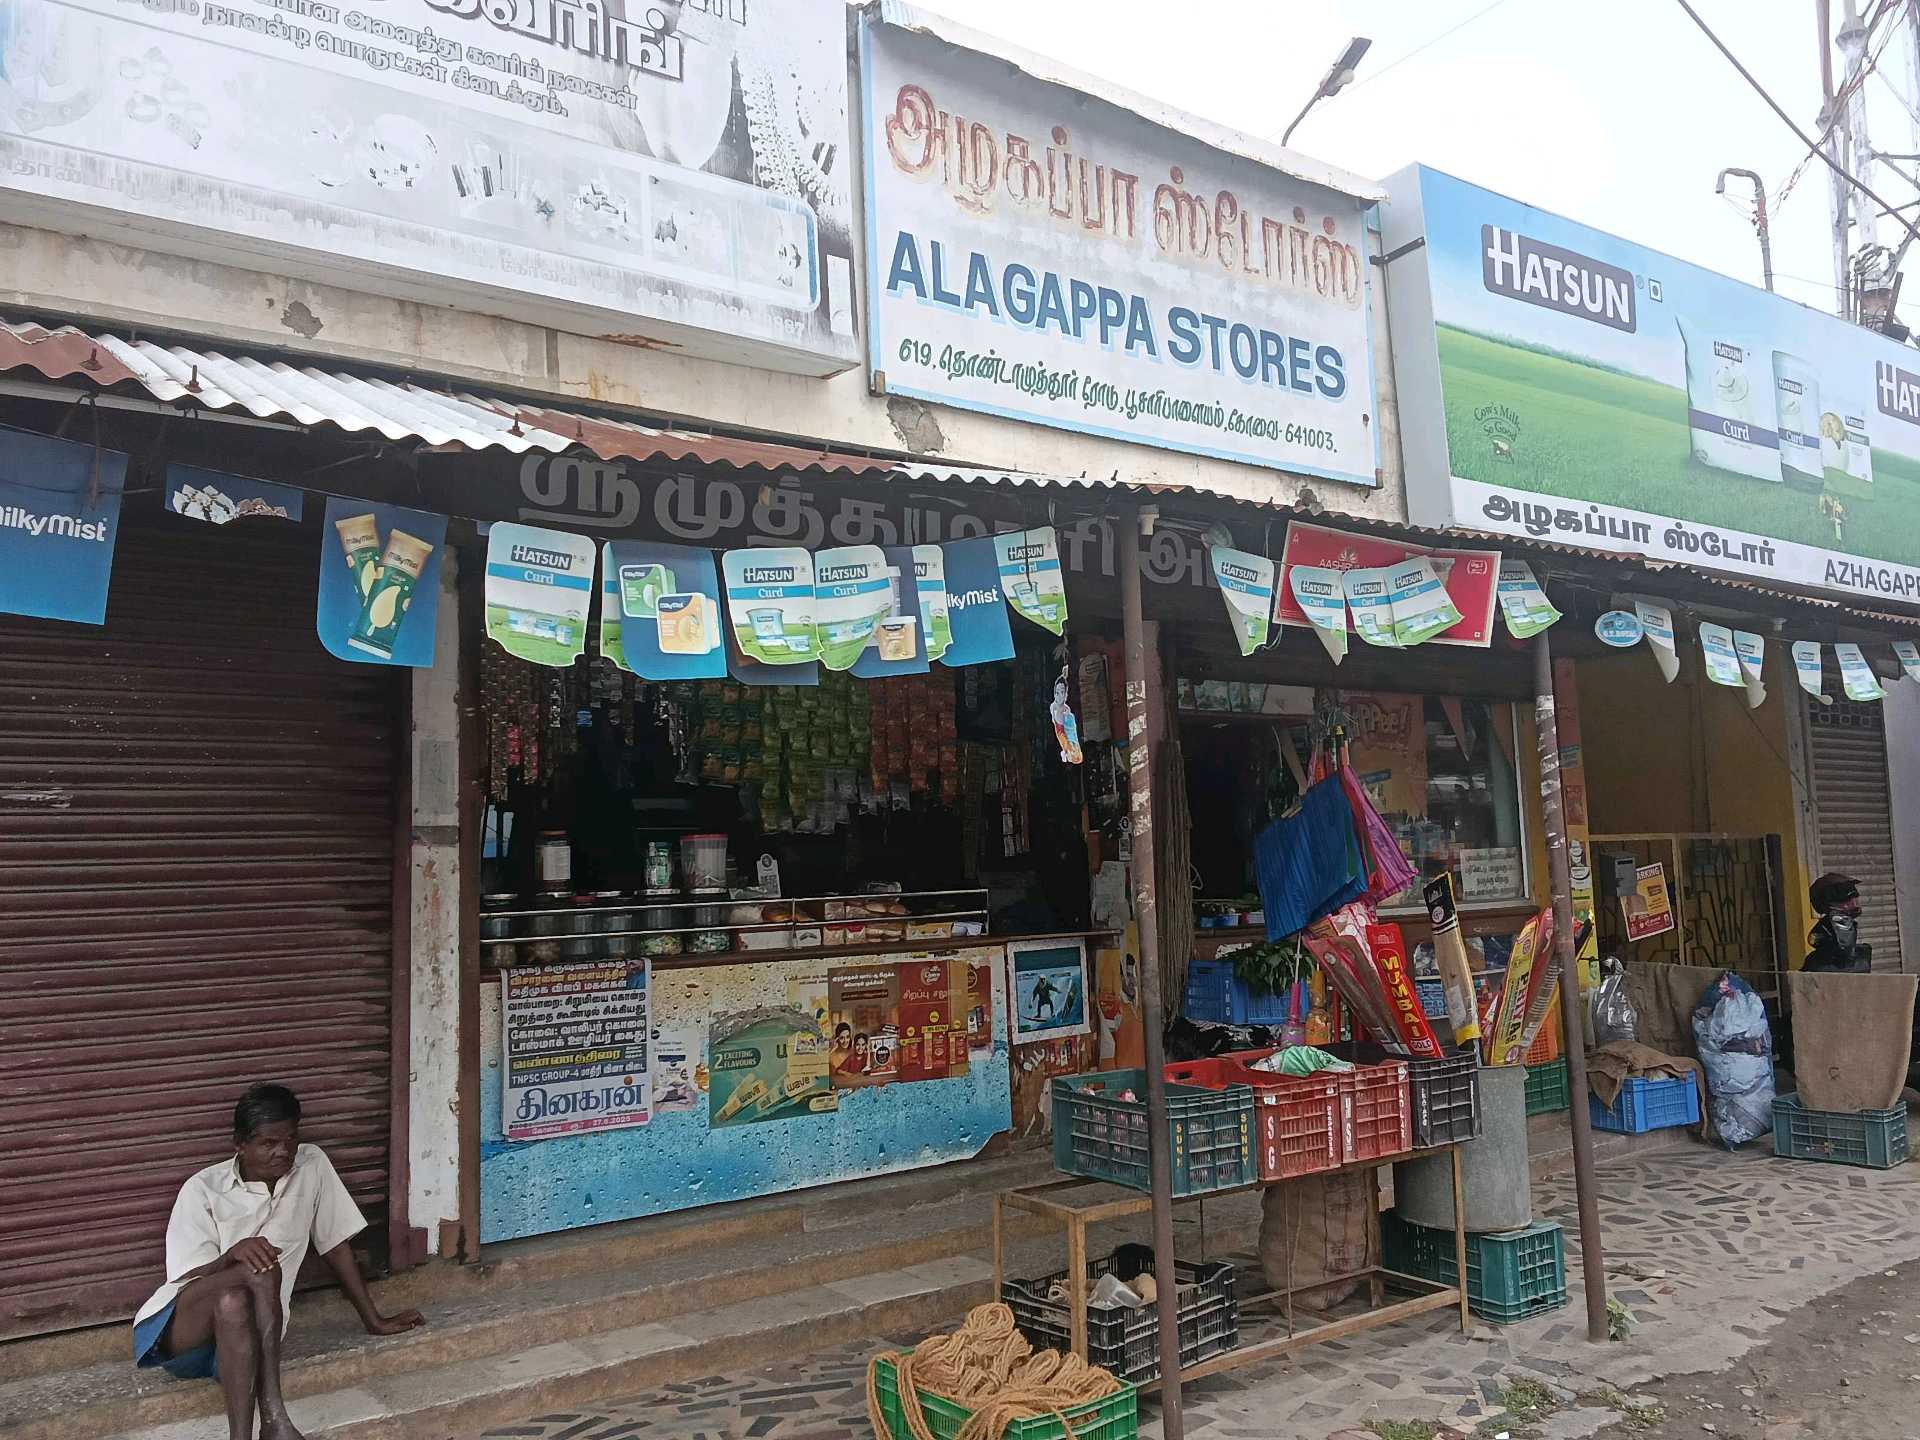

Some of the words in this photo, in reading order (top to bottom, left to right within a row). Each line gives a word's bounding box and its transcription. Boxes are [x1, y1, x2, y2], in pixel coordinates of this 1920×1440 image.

[315, 31, 447, 84] பொருட்கள்
[343, 12, 462, 62] அனைத்து
[466, 46, 545, 83] கவரிங்
[547, 70, 638, 110] நகைகள்
[886, 83, 1138, 239] அழகப்பா
[1485, 225, 1631, 324] HATSUN
[887, 230, 1156, 357] ALAGAPPA
[1167, 306, 1346, 399] STORES
[1722, 420, 1750, 441] Curd
[1482, 493, 1652, 544] அழகப்பா
[1663, 521, 1776, 566] ஸ்டோர்
[512, 545, 571, 570] HATSUN
[524, 570, 554, 585] Curd
[744, 567, 793, 583] HATSUN
[820, 564, 867, 582] HATSUN
[1222, 560, 1257, 581] HATSUN
[1395, 571, 1423, 589] HATSUN
[758, 587, 784, 598] Curd
[833, 584, 859, 597] Curd
[1229, 580, 1247, 592] Curd
[1301, 580, 1332, 595] HATSUN
[1354, 581, 1382, 595] HATSUN
[1636, 866, 1660, 880] ARKING
[1381, 955, 1422, 1037] MUMBAI
[714, 1054, 724, 1070] 2
[511, 1073, 541, 1086] TNPSC
[516, 1075, 645, 1121] தினகரன்
[1240, 1113, 1249, 1167] SUNNY
